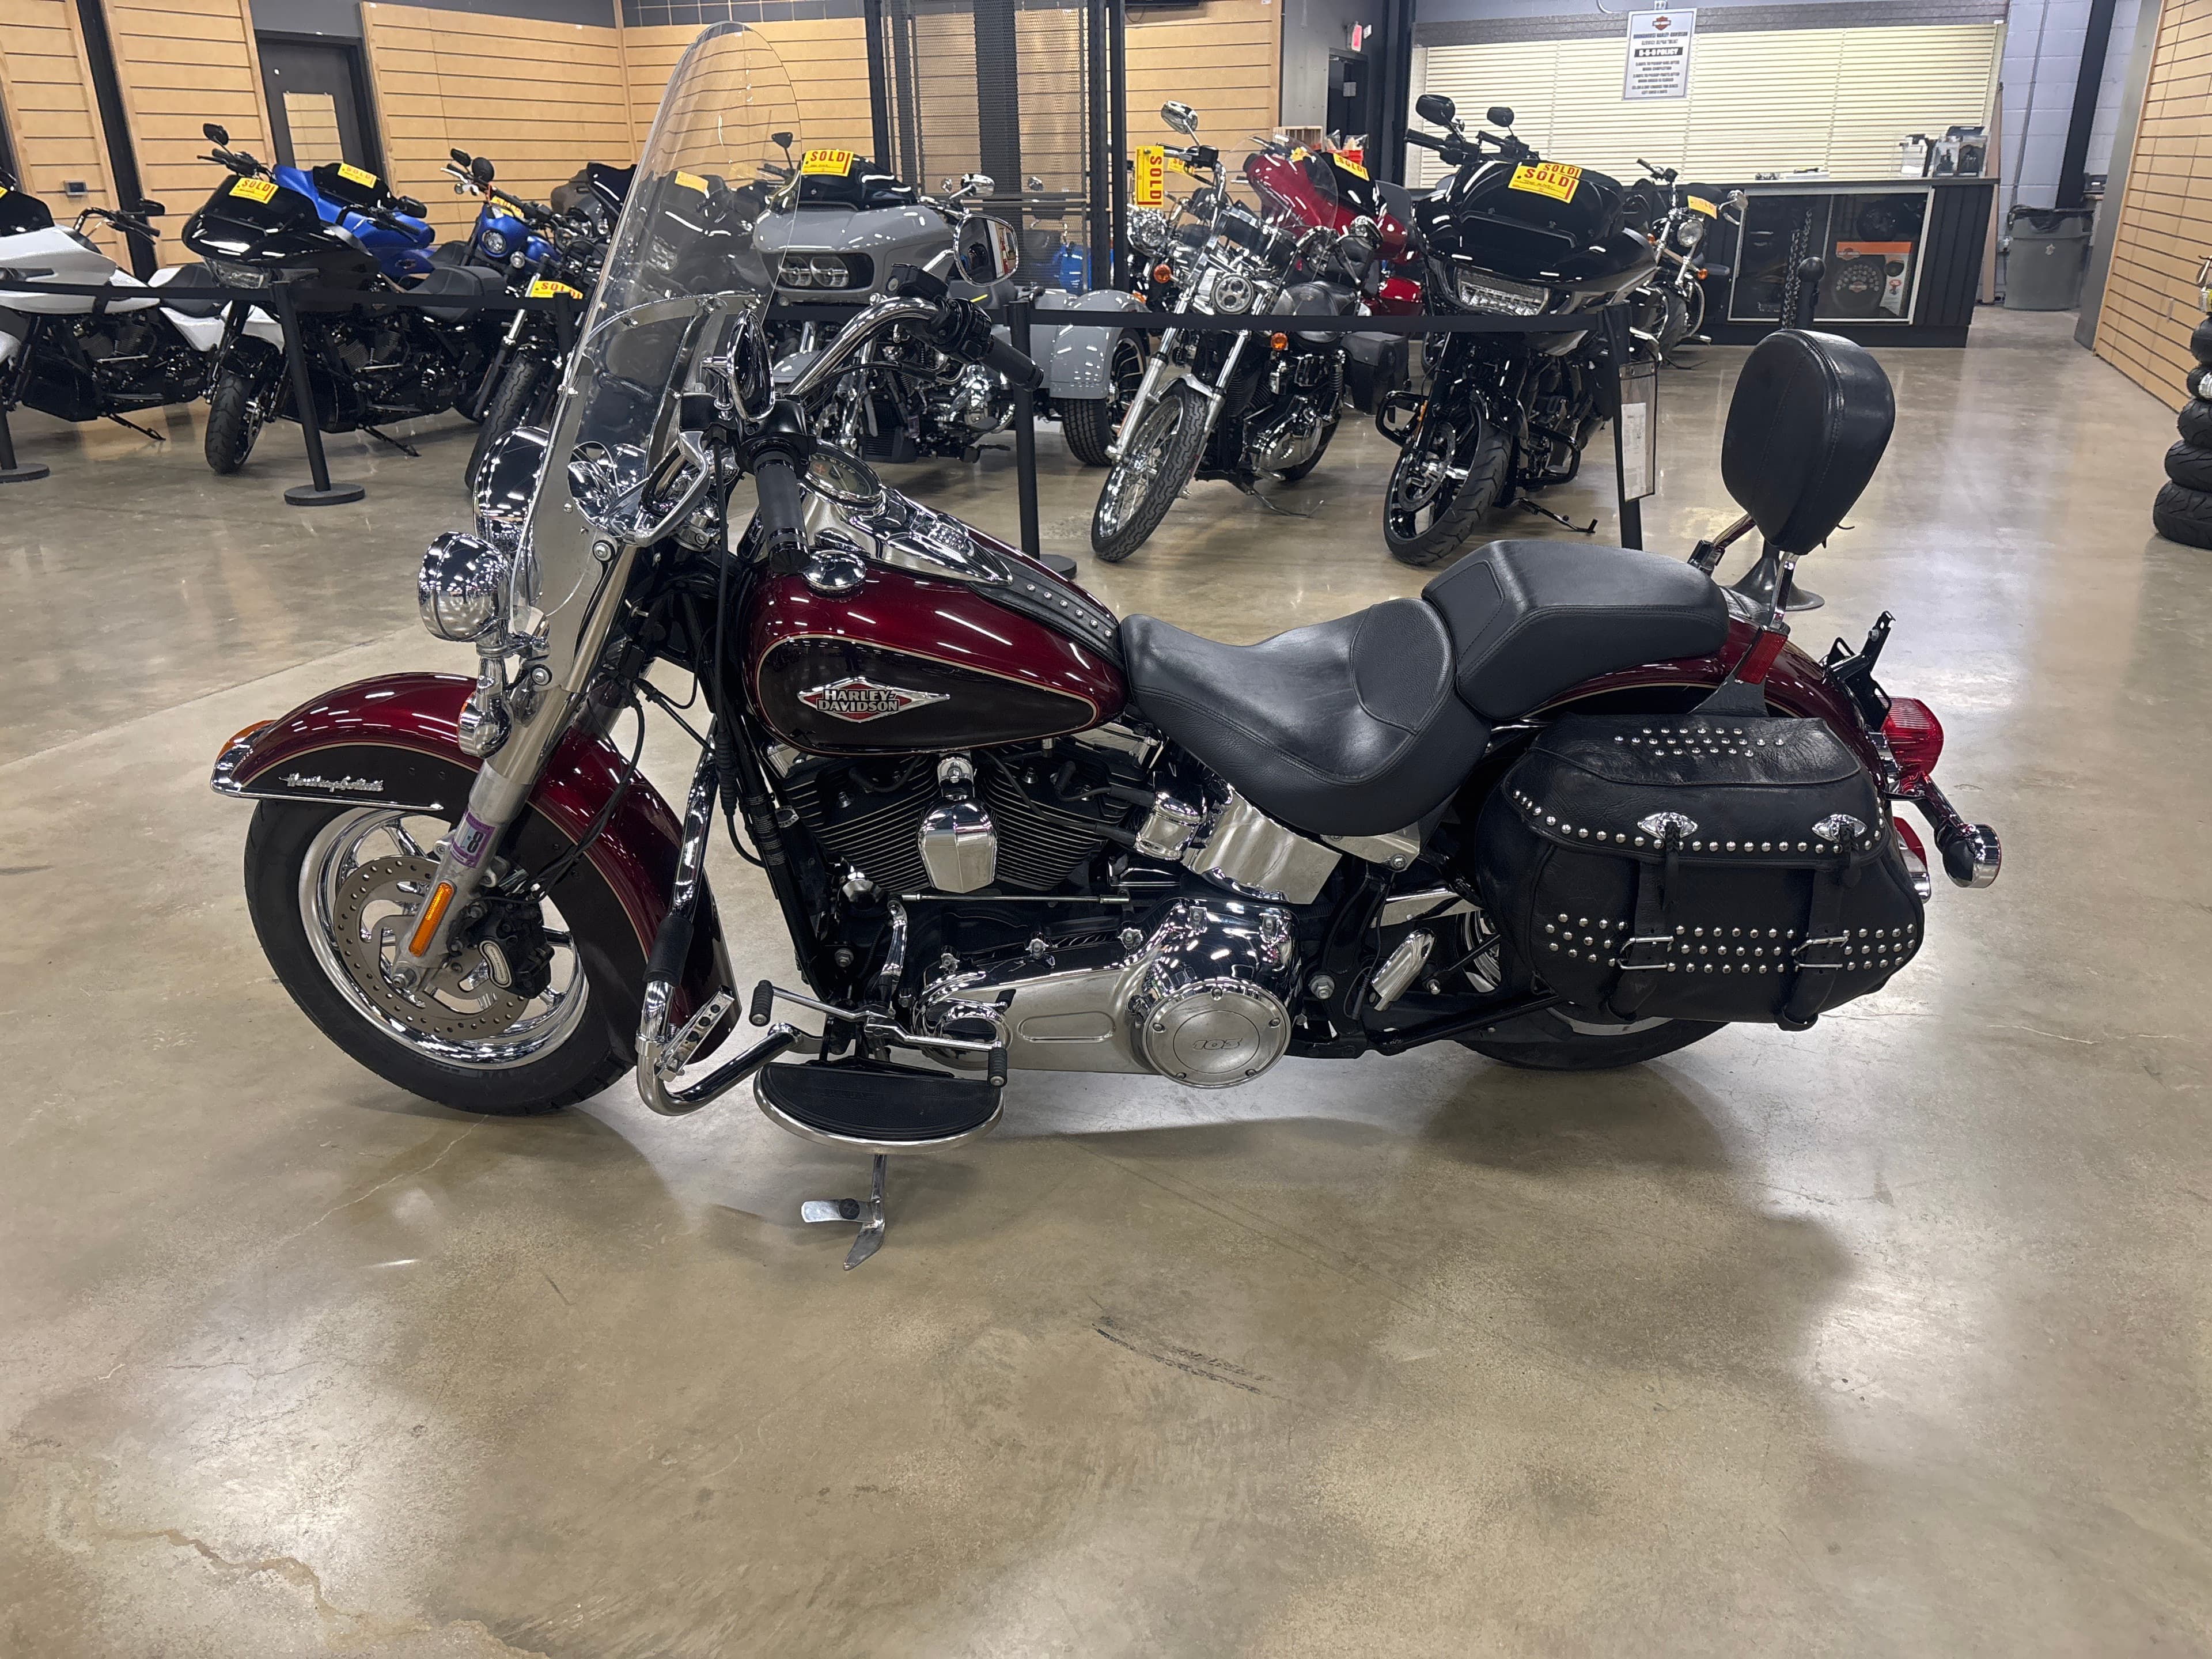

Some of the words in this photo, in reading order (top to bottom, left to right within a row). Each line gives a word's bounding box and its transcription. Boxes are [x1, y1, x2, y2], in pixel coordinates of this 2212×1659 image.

[1657, 48, 1679, 56] POLICY
[810, 151, 845, 162] SOLD
[1338, 157, 1362, 172] SOLD
[1544, 164, 1575, 175] SOLD
[1150, 156, 1162, 199] SOLD
[1524, 168, 1570, 187] SOLD
[241, 179, 271, 192] SOLD
[825, 690, 896, 701] HARLEY-
[819, 700, 898, 712] DAVIDSON
[467, 831, 484, 854] 8
